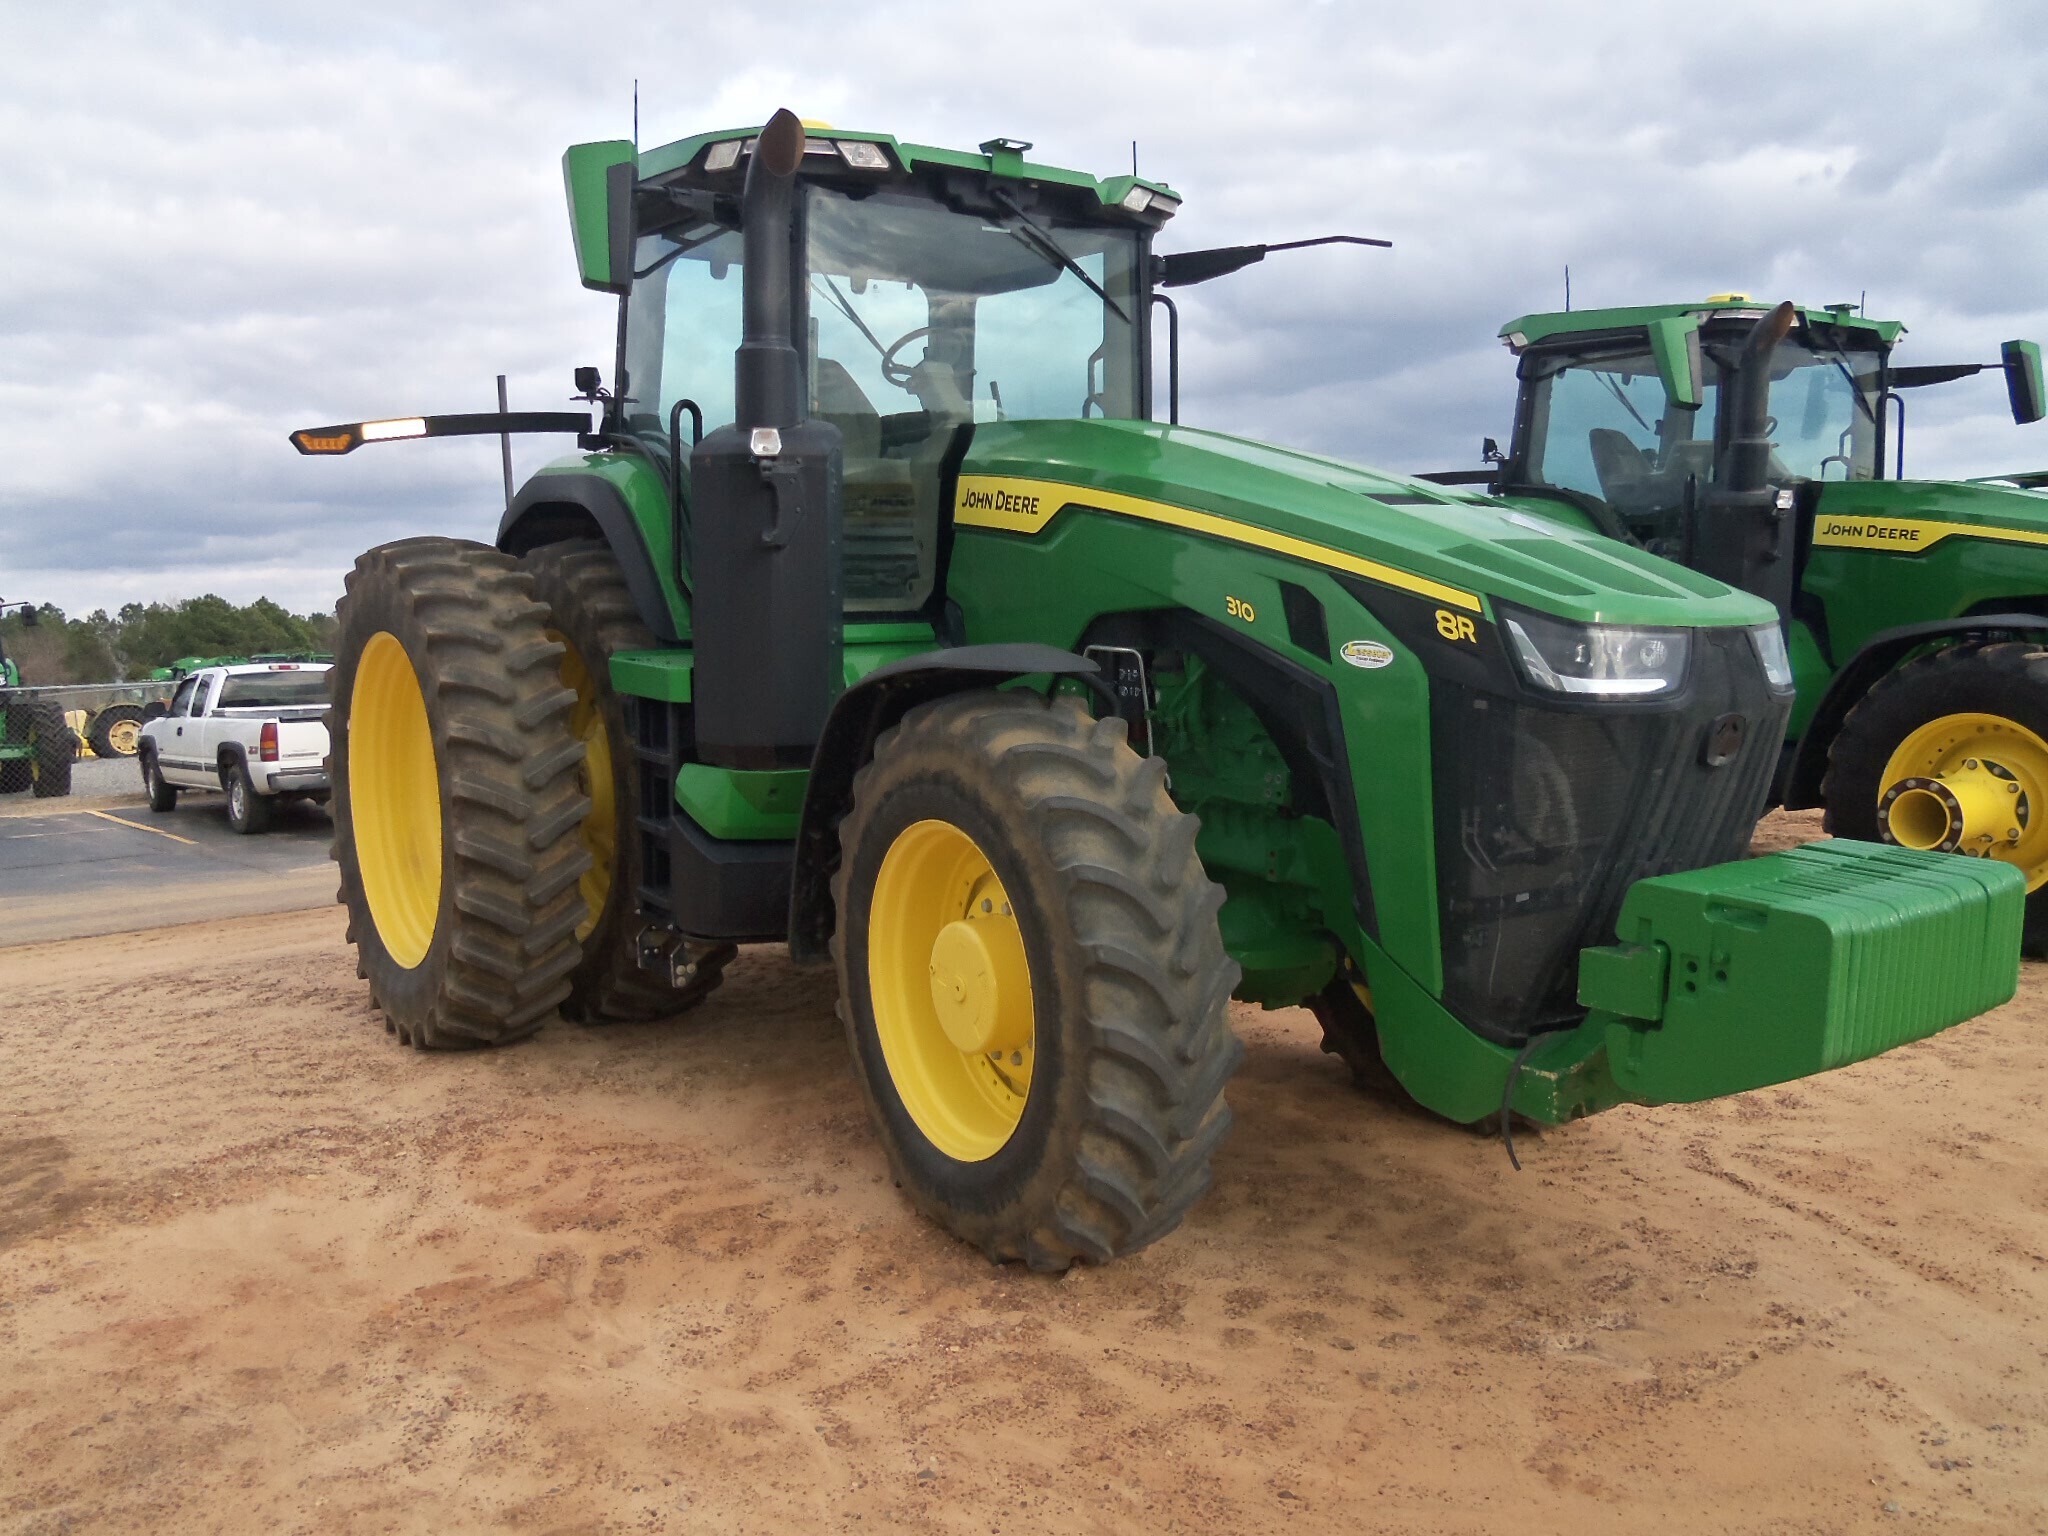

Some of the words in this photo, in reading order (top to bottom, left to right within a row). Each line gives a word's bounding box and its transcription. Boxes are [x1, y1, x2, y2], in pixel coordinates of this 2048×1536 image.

[962, 487, 993, 510] JOHN
[995, 489, 1040, 515] DEERE
[1823, 523, 1863, 537] JOHN
[1866, 525, 1920, 541] DEERE
[1226, 595, 1255, 622] 310
[1435, 609, 1477, 644] 8R
